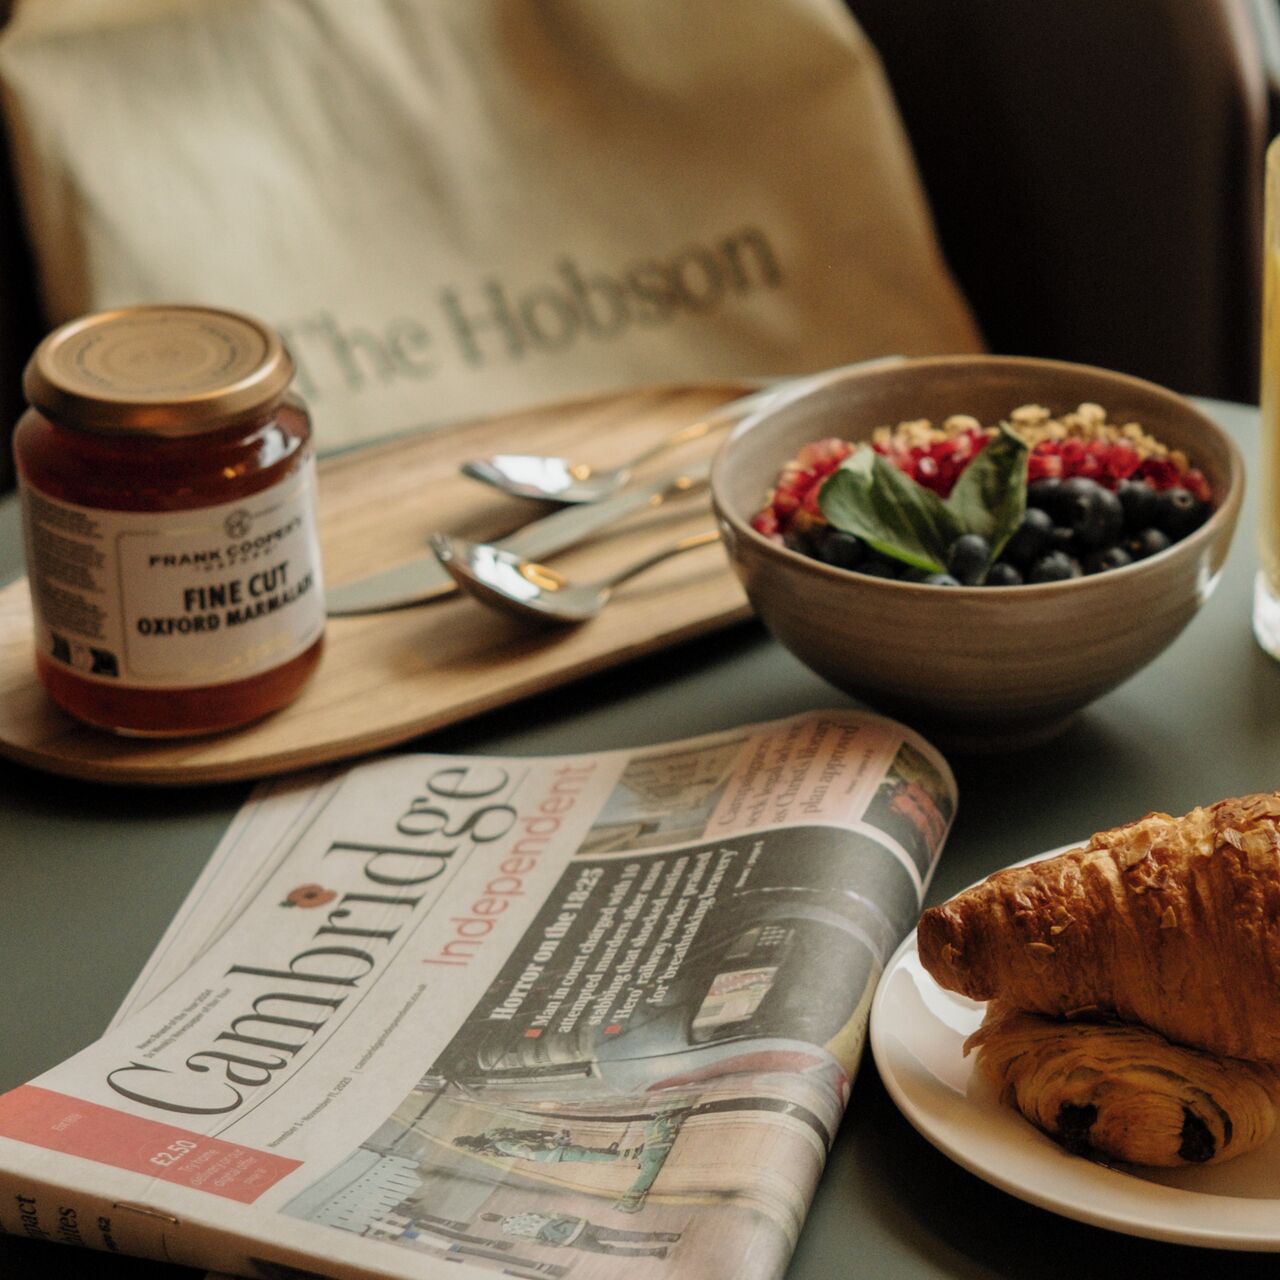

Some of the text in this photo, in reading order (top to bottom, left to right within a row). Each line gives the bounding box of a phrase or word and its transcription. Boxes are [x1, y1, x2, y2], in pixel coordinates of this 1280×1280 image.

[278, 311, 437, 403] The
[439, 227, 783, 368] Hobson
[149, 550, 221, 567] FRANK
[184, 561, 289, 612] FINE CUT
[137, 610, 219, 636] OXFORD
[773, 808, 788, 823] as
[800, 783, 828, 815] plan
[820, 723, 860, 784] approved
[422, 761, 597, 967] Independent
[637, 943, 672, 984] railway
[660, 898, 690, 942] worker
[683, 851, 713, 896] praised
[106, 765, 518, 1115] Cambridge
[489, 868, 604, 1020] Horror on the 18:25
[531, 864, 641, 1026] Man in court charged with 10
[558, 860, 666, 1033] attempted murders after mass
[588, 856, 689, 1025] stabbing that shocked nation
[647, 984, 669, 1004] for
[150, 1140, 197, 1167] £2.50
[267, 1126, 298, 1147] November
[303, 1098, 332, 1122] November
